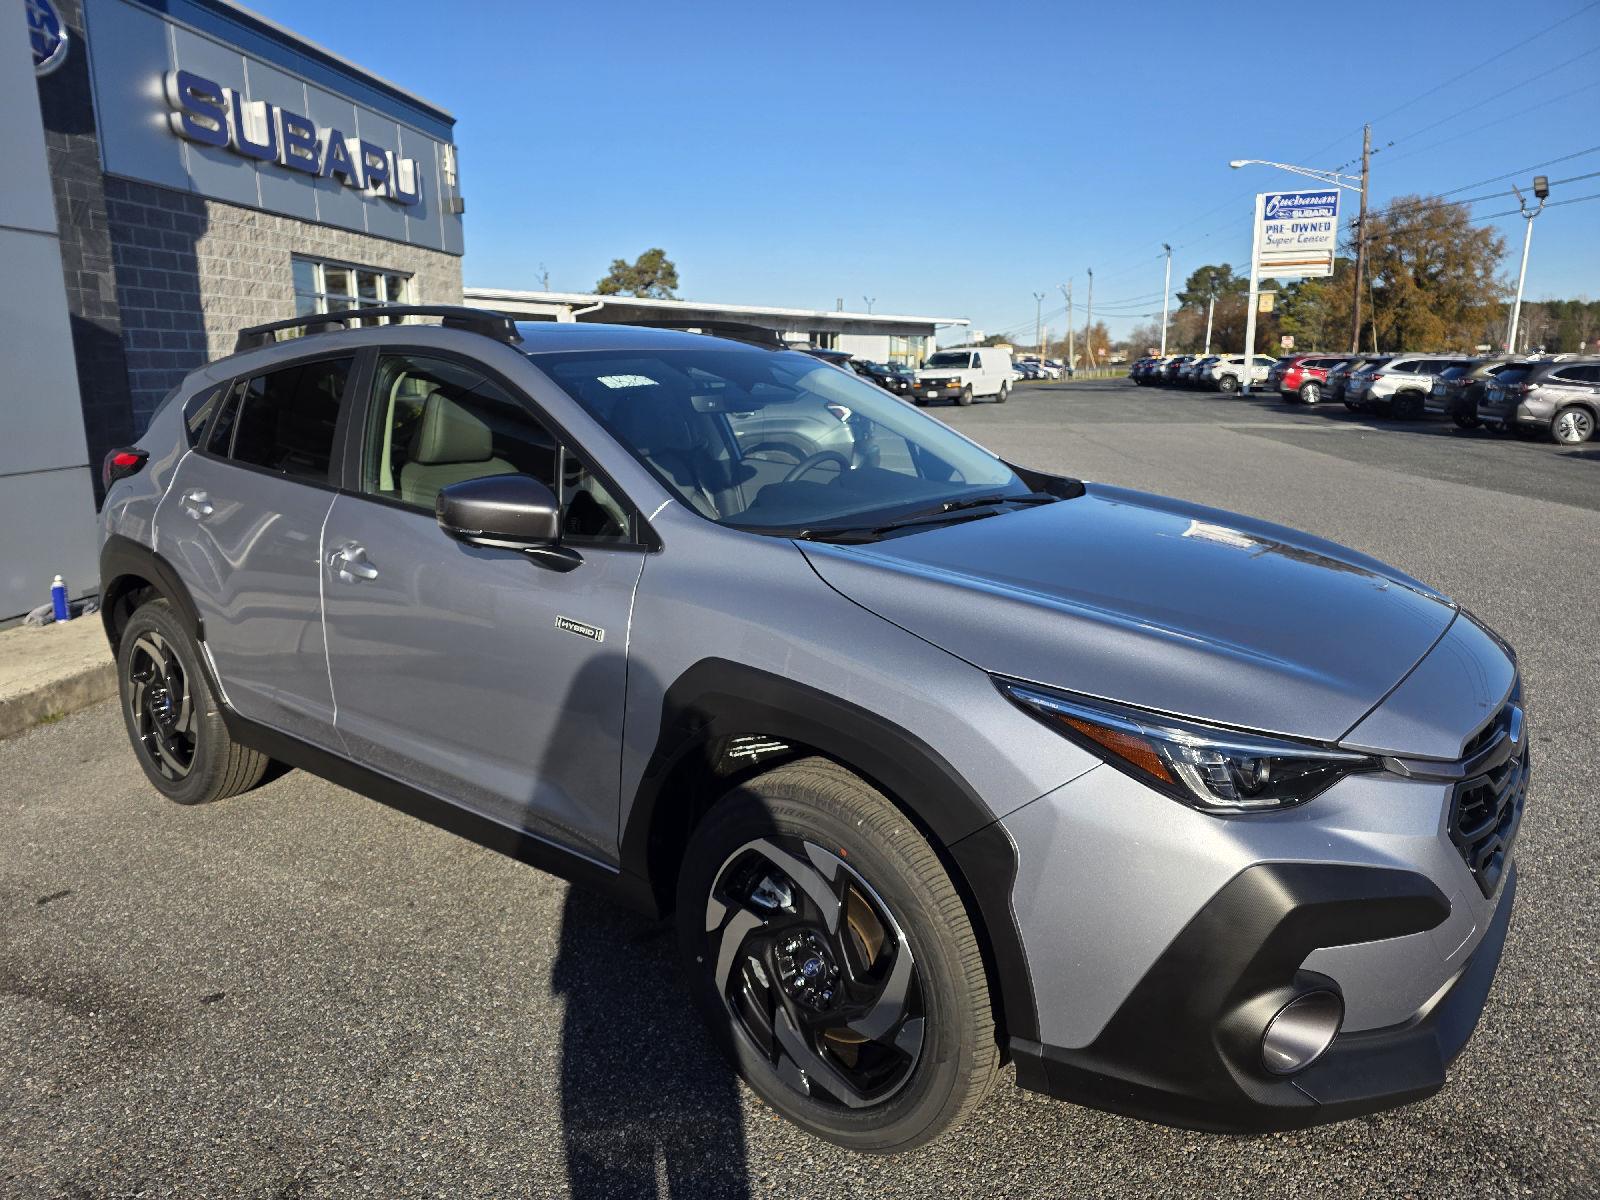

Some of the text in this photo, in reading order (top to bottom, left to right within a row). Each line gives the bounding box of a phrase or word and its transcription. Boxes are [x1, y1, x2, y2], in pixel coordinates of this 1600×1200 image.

[167, 69, 421, 205] SUBARU
[1266, 195, 1336, 216] Buchanan
[1292, 208, 1332, 217] SUBARU
[1266, 222, 1331, 234] PRE-OWNED
[1266, 233, 1330, 247] Super Center
[561, 621, 595, 636] HYBRID
